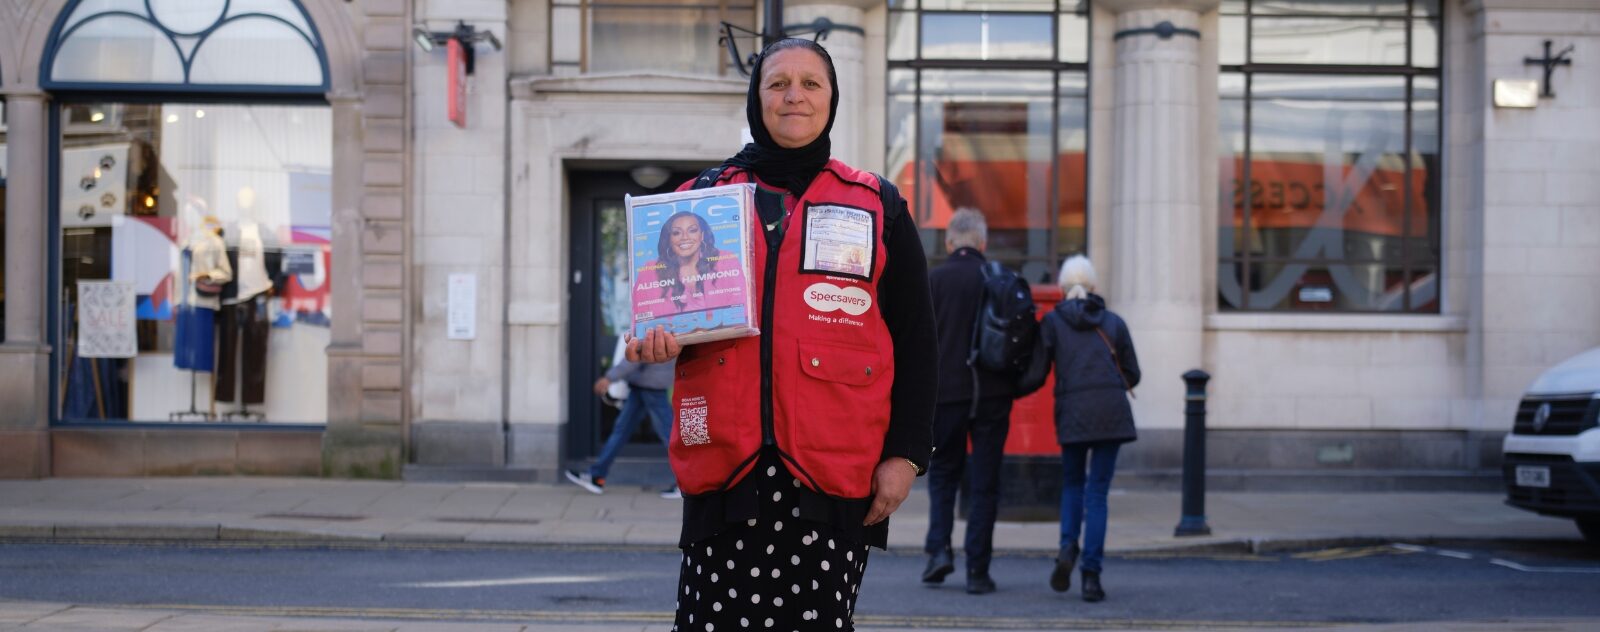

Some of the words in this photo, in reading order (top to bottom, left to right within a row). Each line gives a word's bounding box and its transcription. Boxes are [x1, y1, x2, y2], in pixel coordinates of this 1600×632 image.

[637, 278, 676, 291] ALISON
[682, 269, 740, 284] HAMMOND
[810, 290, 866, 307] Specsavers
[809, 314, 831, 324] Making
[838, 317, 864, 327] difference
